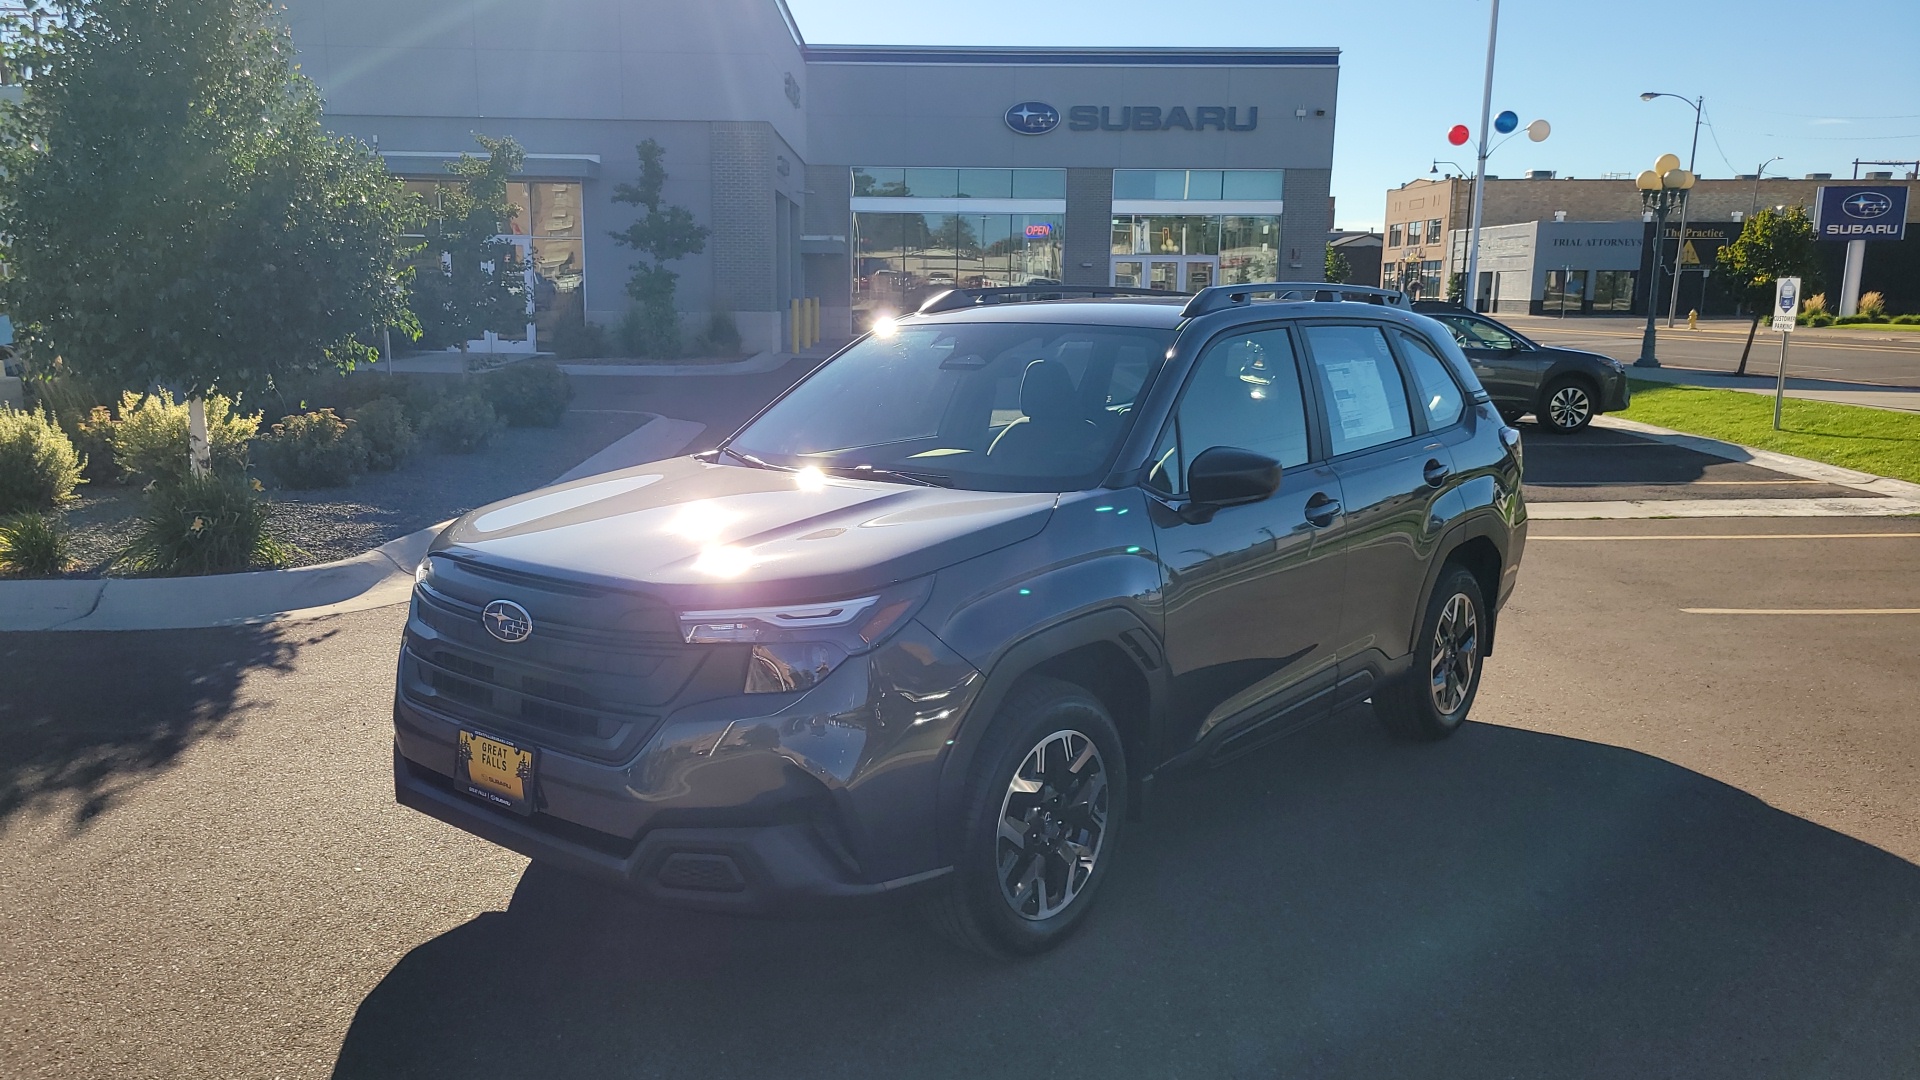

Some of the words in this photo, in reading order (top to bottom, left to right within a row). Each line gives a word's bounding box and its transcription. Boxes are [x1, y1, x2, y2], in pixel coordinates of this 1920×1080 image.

[1068, 105, 1258, 132] SUBARU
[1025, 225, 1050, 236] OPEN
[1685, 228, 1724, 238] Practice
[1826, 224, 1898, 235] SUBARU
[1553, 238, 1582, 247] TRIAL
[1585, 238, 1643, 247] ATTORNEYS
[482, 742, 507, 759] GREAT
[482, 754, 507, 771] FALLS
